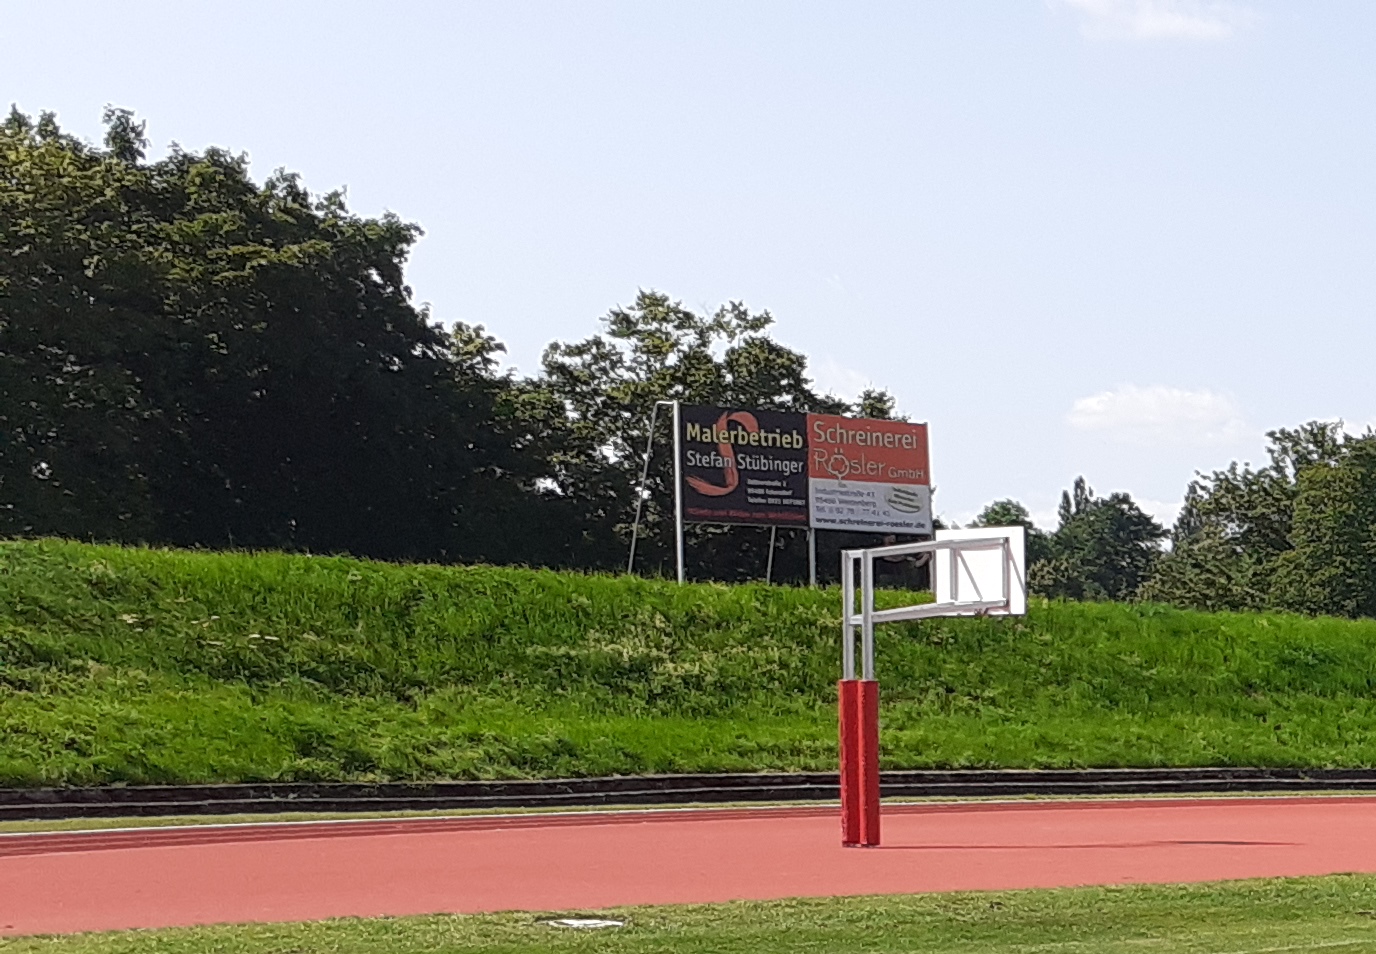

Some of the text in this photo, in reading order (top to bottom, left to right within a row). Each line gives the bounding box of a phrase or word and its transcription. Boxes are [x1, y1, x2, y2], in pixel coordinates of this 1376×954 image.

[686, 422, 803, 448] Malerbetrieb
[813, 420, 917, 449] Schreinerei
[686, 450, 804, 475] Stefan Stübinger
[813, 447, 924, 480] Rösler GmbH
